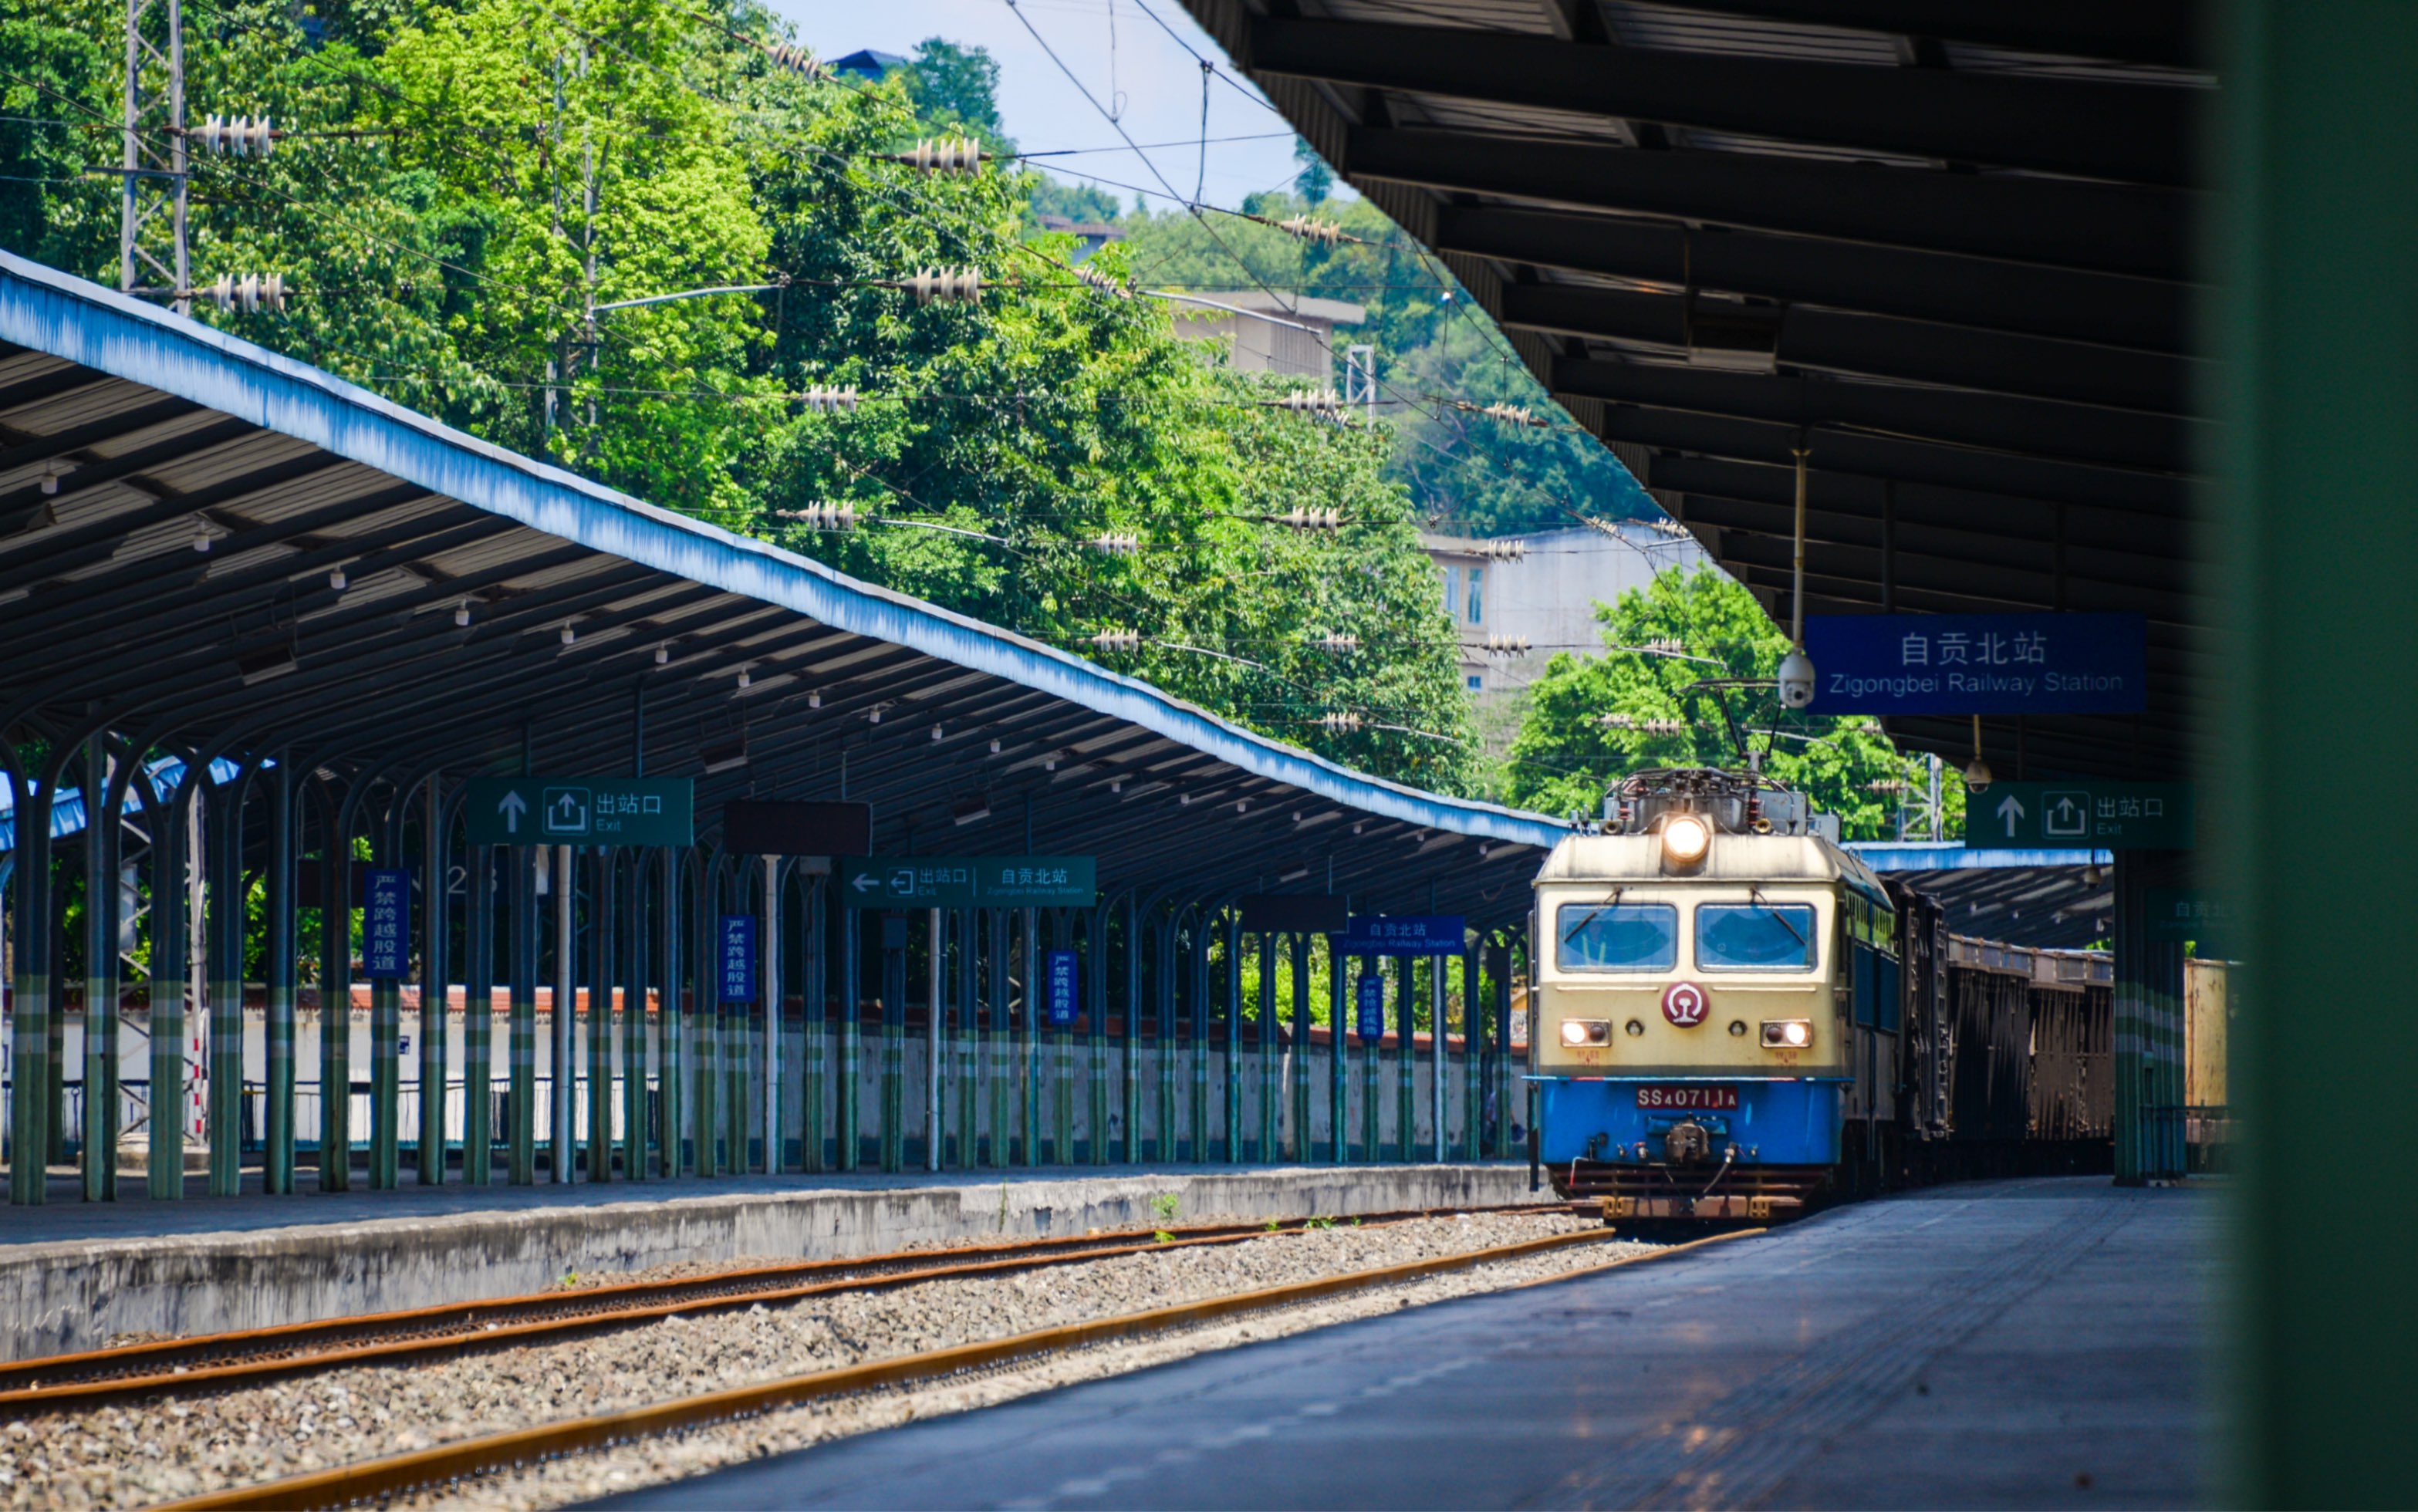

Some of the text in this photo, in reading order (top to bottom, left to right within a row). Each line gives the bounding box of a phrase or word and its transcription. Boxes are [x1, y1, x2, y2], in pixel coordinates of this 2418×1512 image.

[1902, 631, 2047, 666] 自贡北站
[1829, 672, 2123, 697] Zigongbei Railway Station
[597, 793, 660, 814] 出站口
[2098, 796, 2163, 817] 出站口
[596, 818, 621, 832] Exit
[2098, 822, 2122, 835] Exit
[919, 867, 967, 884] 出站口
[1001, 868, 1068, 885] 自贡北站
[2176, 901, 2230, 918] 自贡北
[373, 875, 397, 970] 严禁跨越股道
[1370, 923, 1427, 937] 自贡北站
[728, 920, 745, 996] 严禁跨越股道
